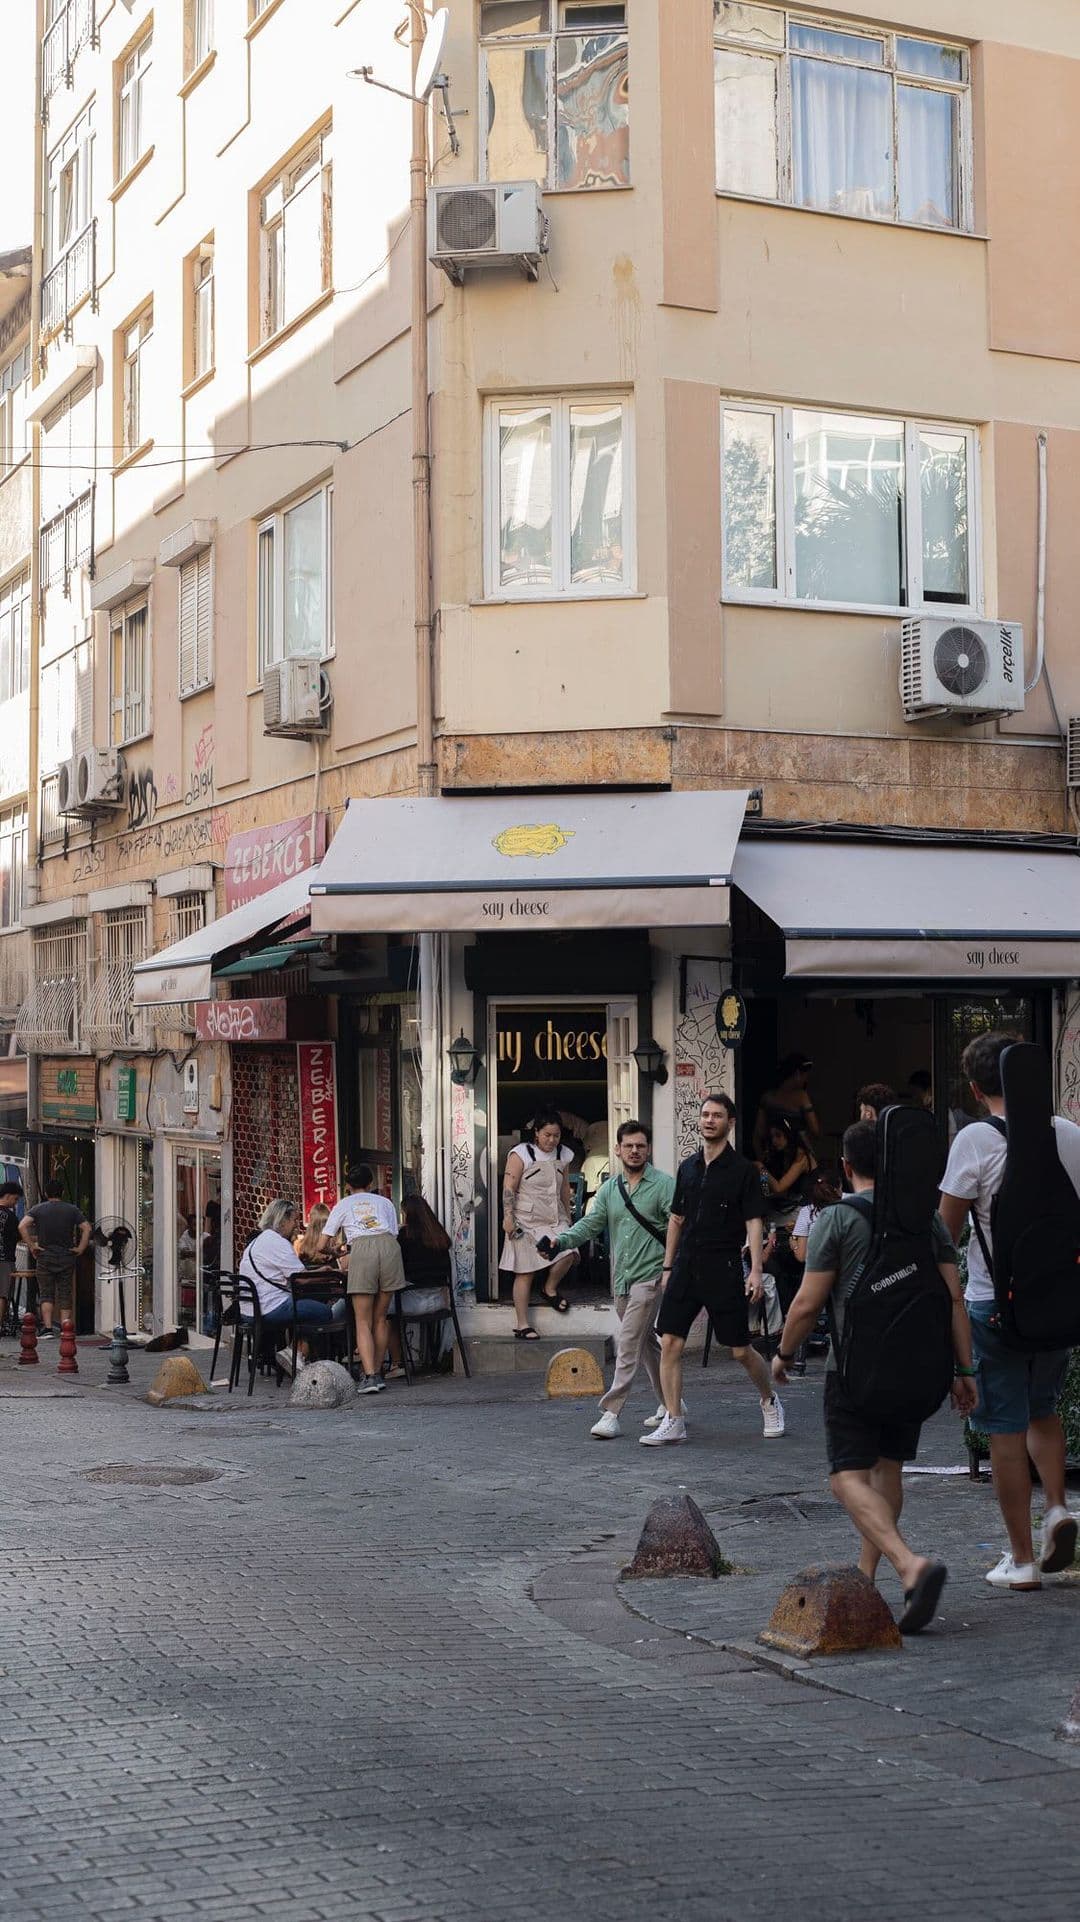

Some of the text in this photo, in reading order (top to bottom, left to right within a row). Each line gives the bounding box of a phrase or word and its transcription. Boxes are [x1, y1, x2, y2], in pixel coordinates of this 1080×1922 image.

[1000, 627, 1015, 683] arçelik
[482, 898, 550, 920] say cheese
[967, 947, 1020, 969] say cheese
[496, 1031, 521, 1073] ay
[310, 1049, 330, 1203] ZEBERCET
